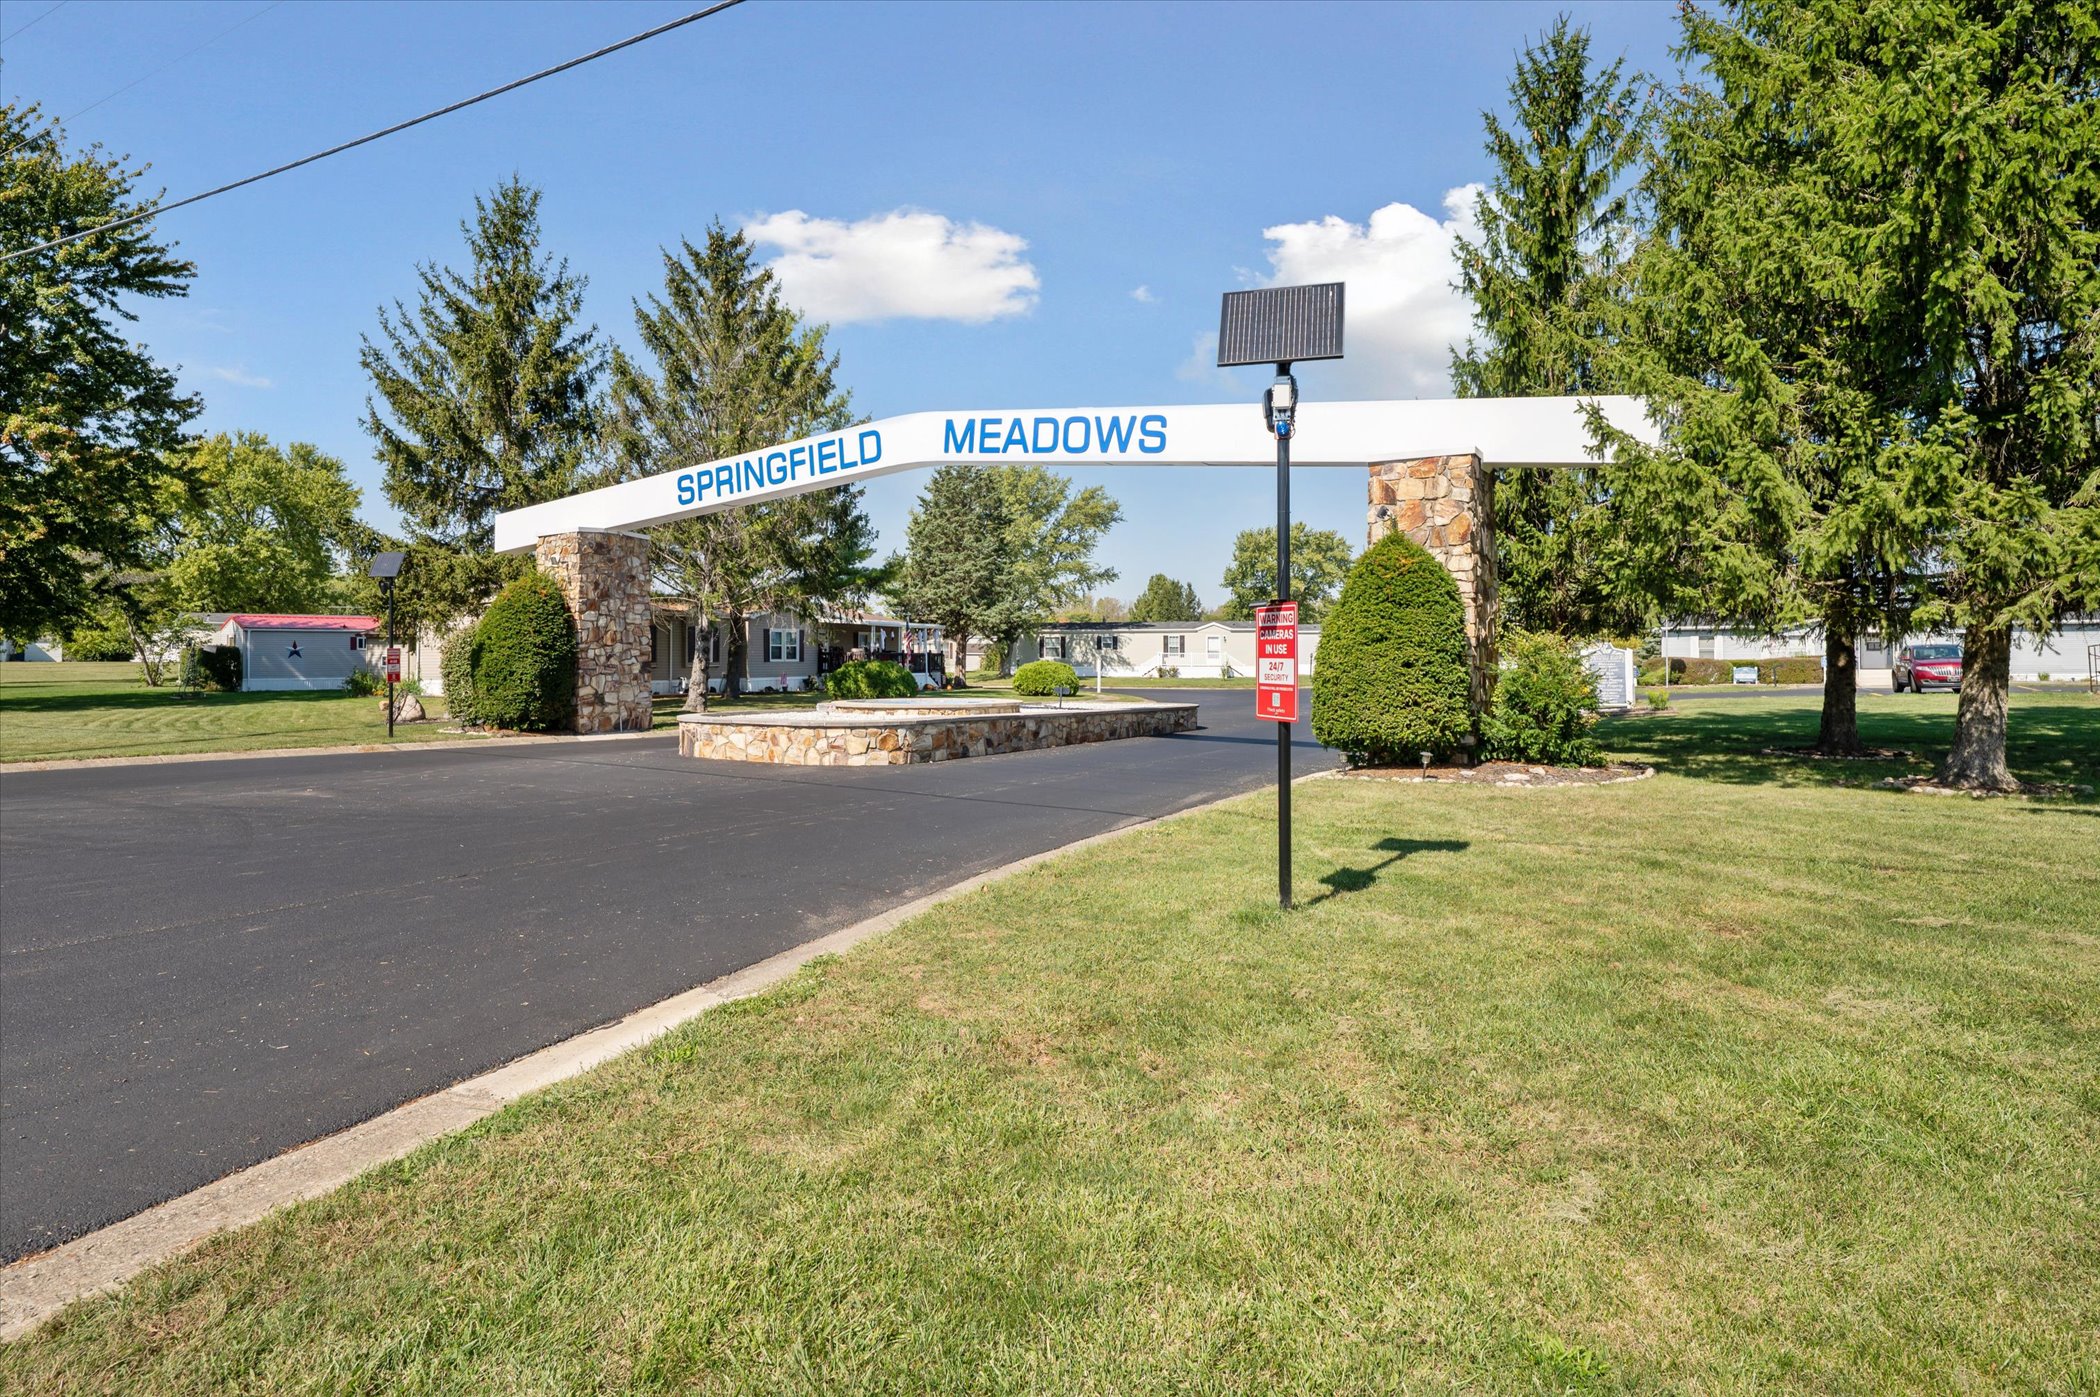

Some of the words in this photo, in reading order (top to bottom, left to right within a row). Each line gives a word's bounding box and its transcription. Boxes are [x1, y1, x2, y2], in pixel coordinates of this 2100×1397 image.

[677, 429, 882, 505] SPRINGFIELD
[943, 414, 1167, 454] MEADOWS
[1259, 612, 1294, 624] WARNING
[1260, 629, 1294, 640] CAMERAS
[1265, 643, 1273, 655] IN
[1273, 643, 1288, 655] USE
[1268, 661, 1284, 672] 24/7
[1264, 673, 1289, 681] SECURITY
